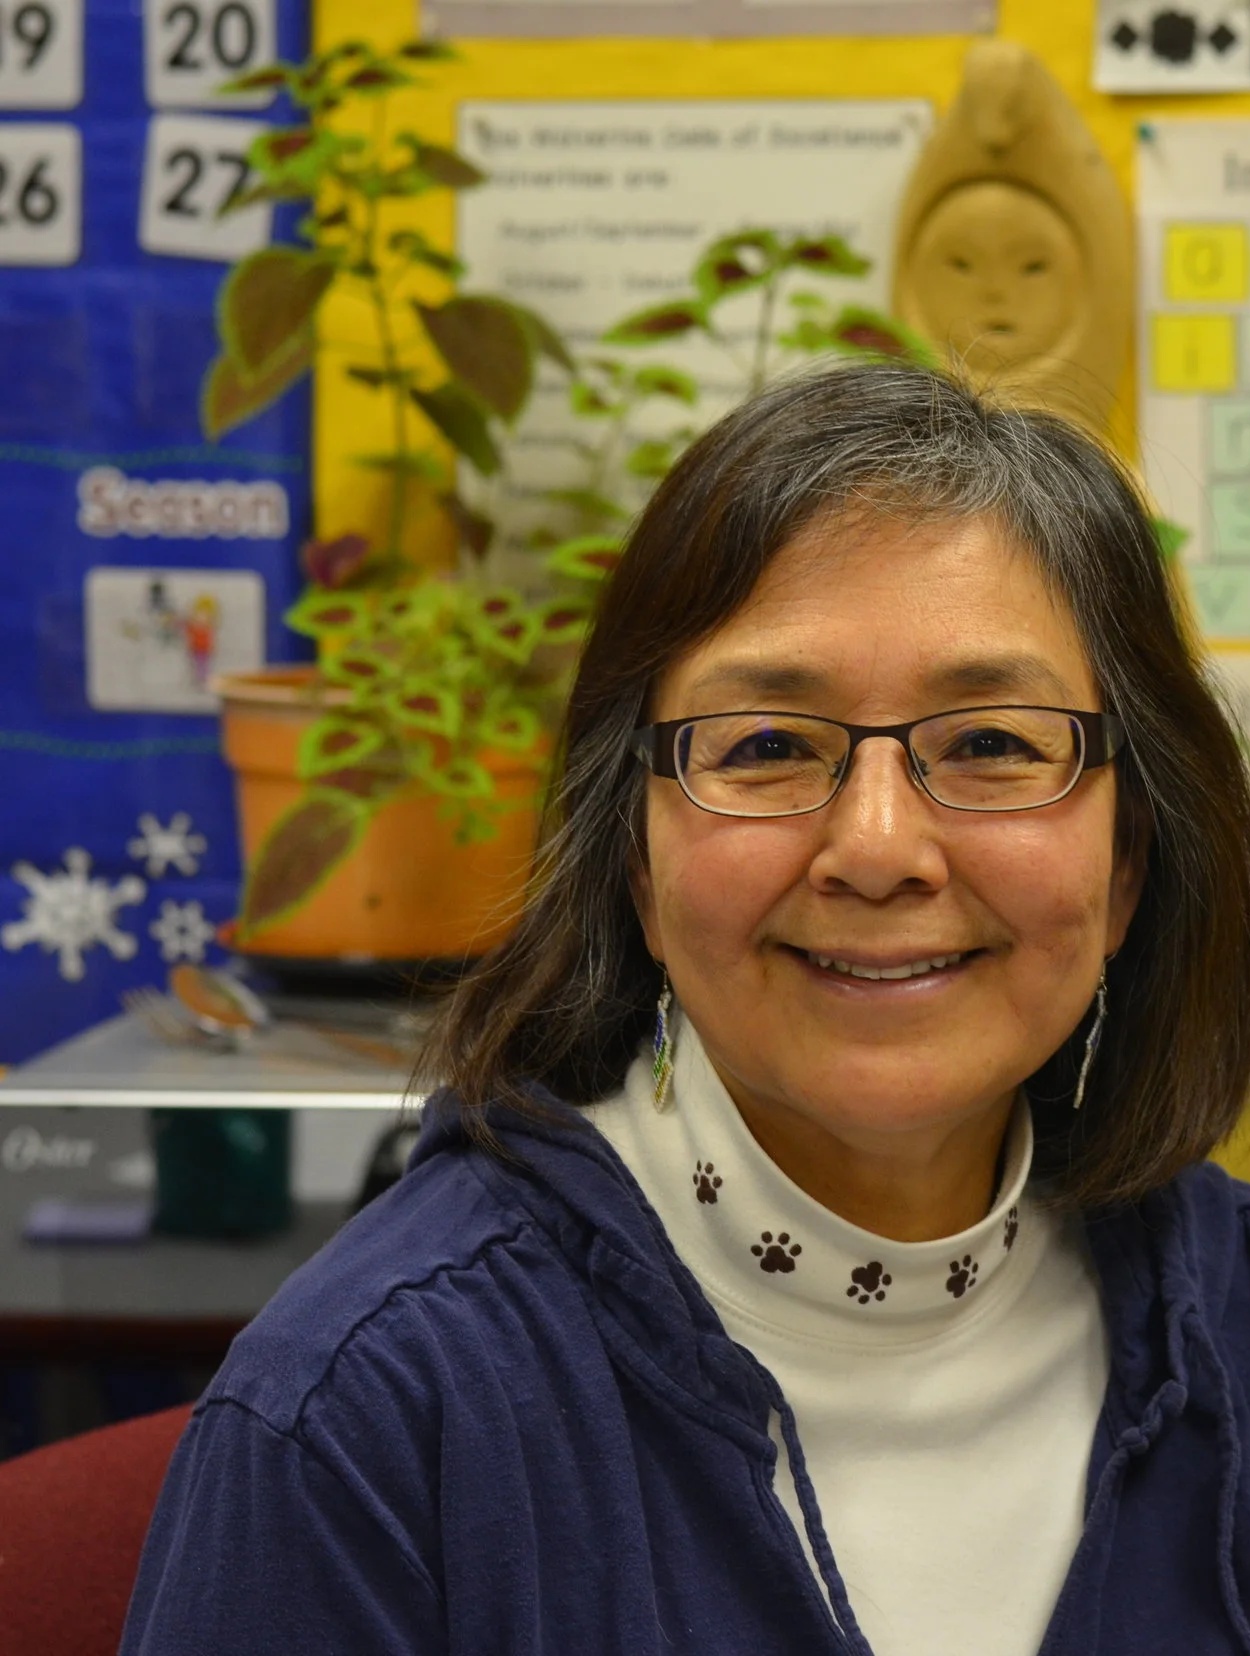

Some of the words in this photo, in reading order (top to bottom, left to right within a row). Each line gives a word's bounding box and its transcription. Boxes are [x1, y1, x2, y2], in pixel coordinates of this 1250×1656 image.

[0, 3, 54, 71] 9
[164, 3, 257, 69] 20
[0, 156, 58, 225] 6
[164, 150, 252, 217] 27
[80, 468, 287, 537] Season
